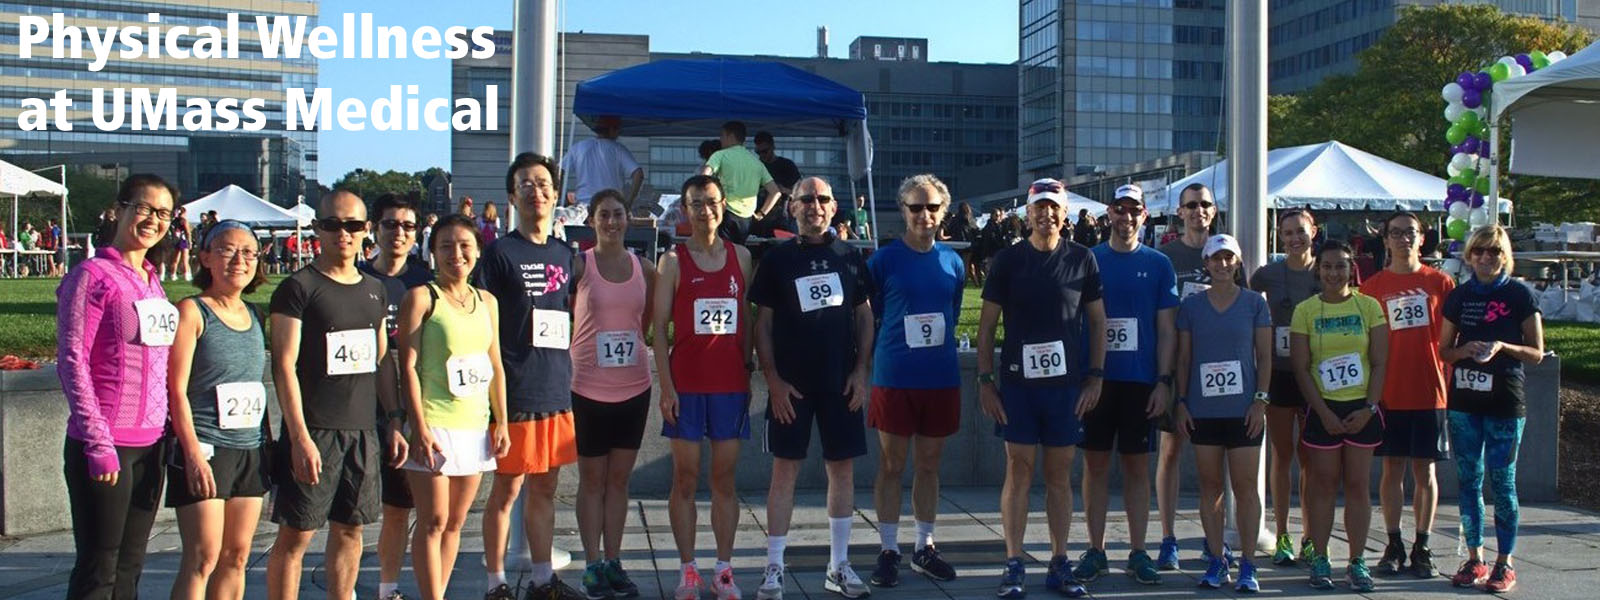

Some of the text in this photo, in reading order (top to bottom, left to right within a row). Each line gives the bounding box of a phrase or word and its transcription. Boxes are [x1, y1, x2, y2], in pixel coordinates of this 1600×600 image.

[809, 284, 831, 300] 89
[700, 309, 732, 325] 242
[1393, 305, 1424, 321] 238
[147, 314, 175, 333] 246
[921, 324, 932, 338] 9
[1106, 328, 1126, 342] 96
[604, 342, 634, 358] 147
[1029, 352, 1060, 369] 160
[1205, 371, 1237, 388] 202
[1327, 363, 1358, 382] 176
[1458, 368, 1487, 382] 166
[226, 397, 262, 417] 224
